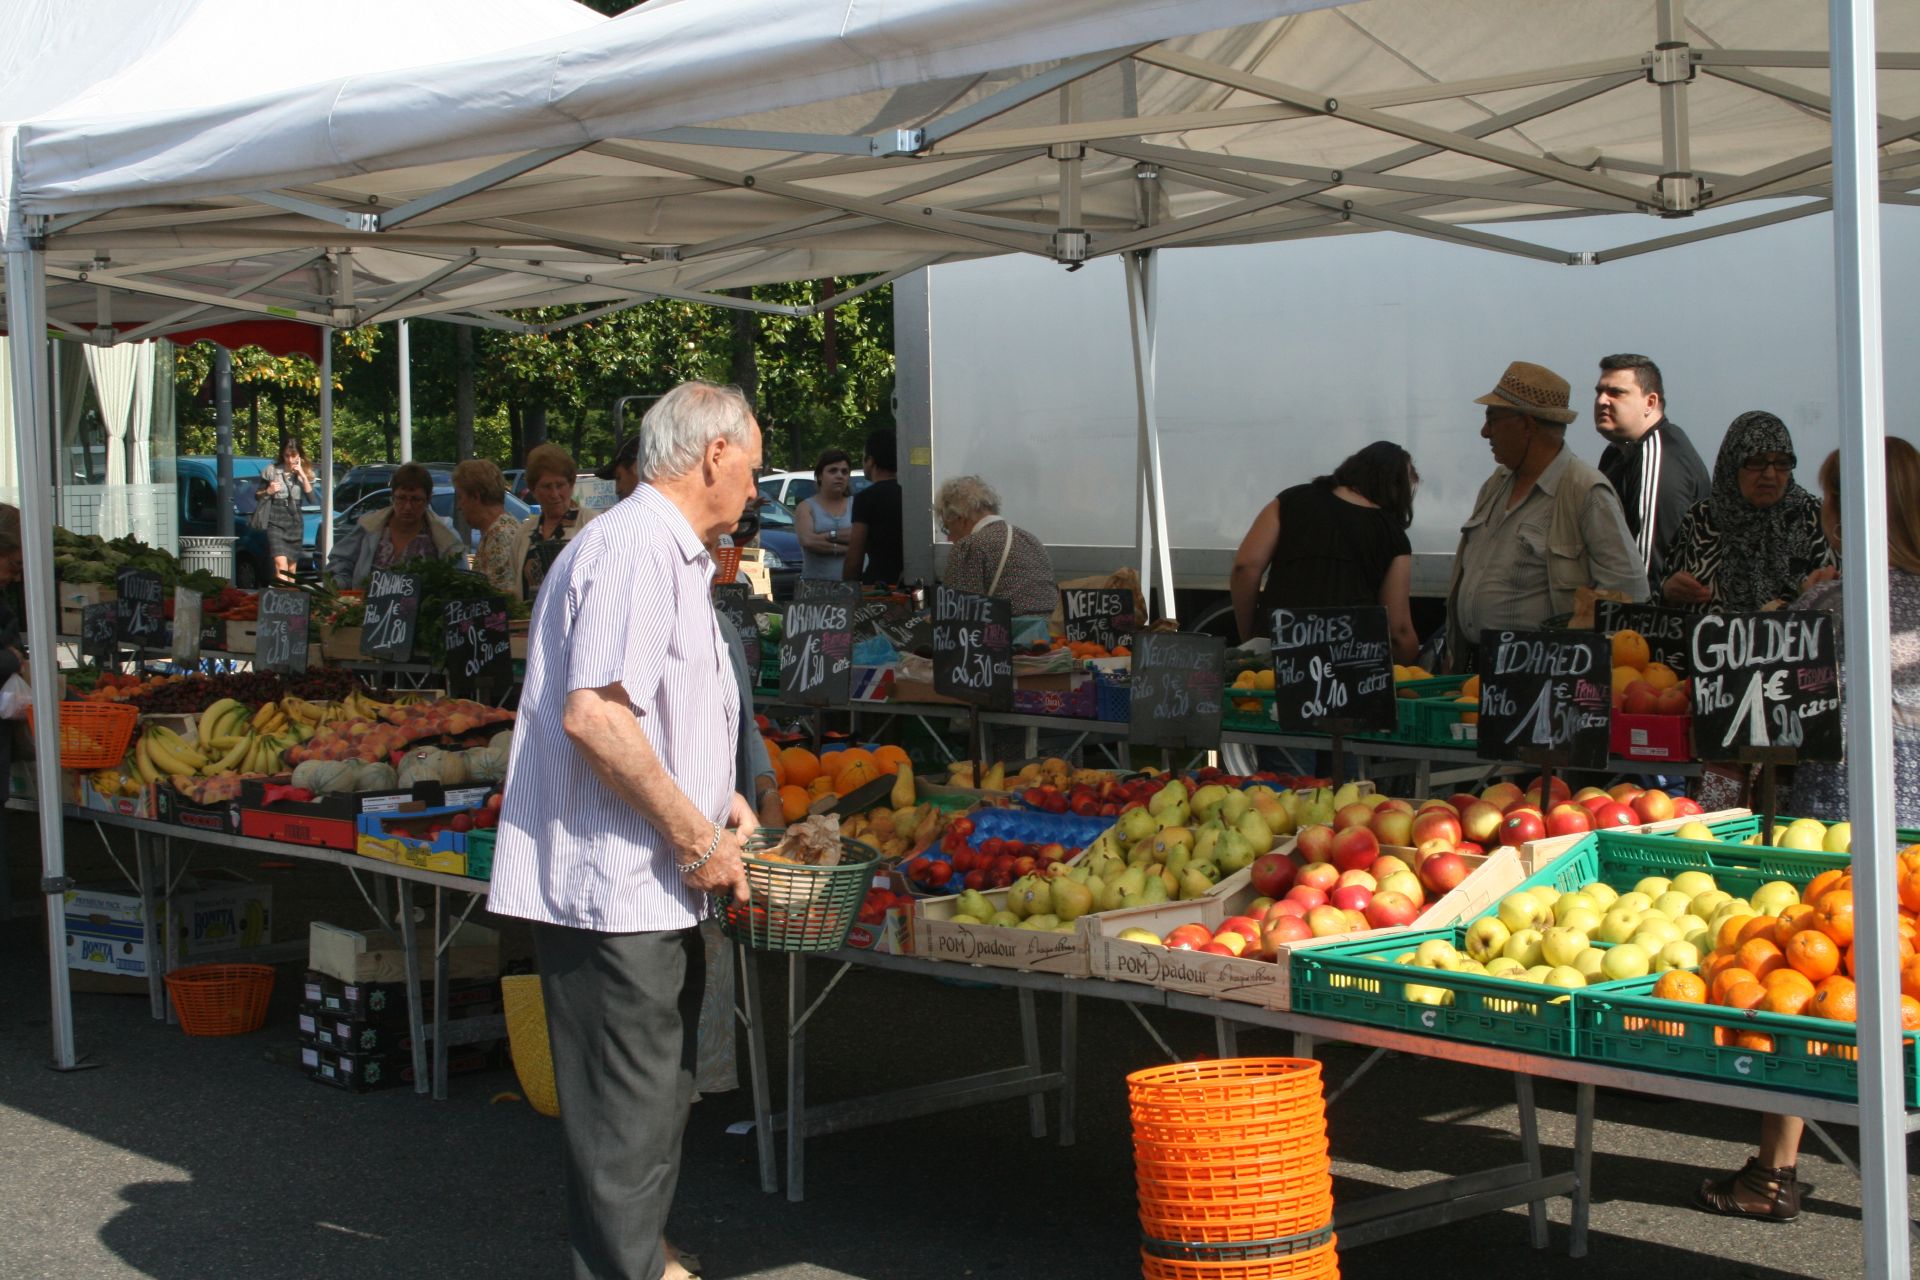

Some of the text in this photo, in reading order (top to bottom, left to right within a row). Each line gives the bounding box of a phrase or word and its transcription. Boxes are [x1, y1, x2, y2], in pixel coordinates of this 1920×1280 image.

[367, 570, 414, 598] BANANES
[786, 602, 847, 640] ORANGES
[936, 586, 993, 623] ABATTE
[1066, 590, 1122, 619] NEFLES
[1692, 614, 1826, 673] GOLDEN
[1480, 682, 1517, 717] Kilo
[1694, 674, 1735, 716] Kilo
[193, 908, 237, 940] BONITA
[81, 940, 115, 964] BONITA
